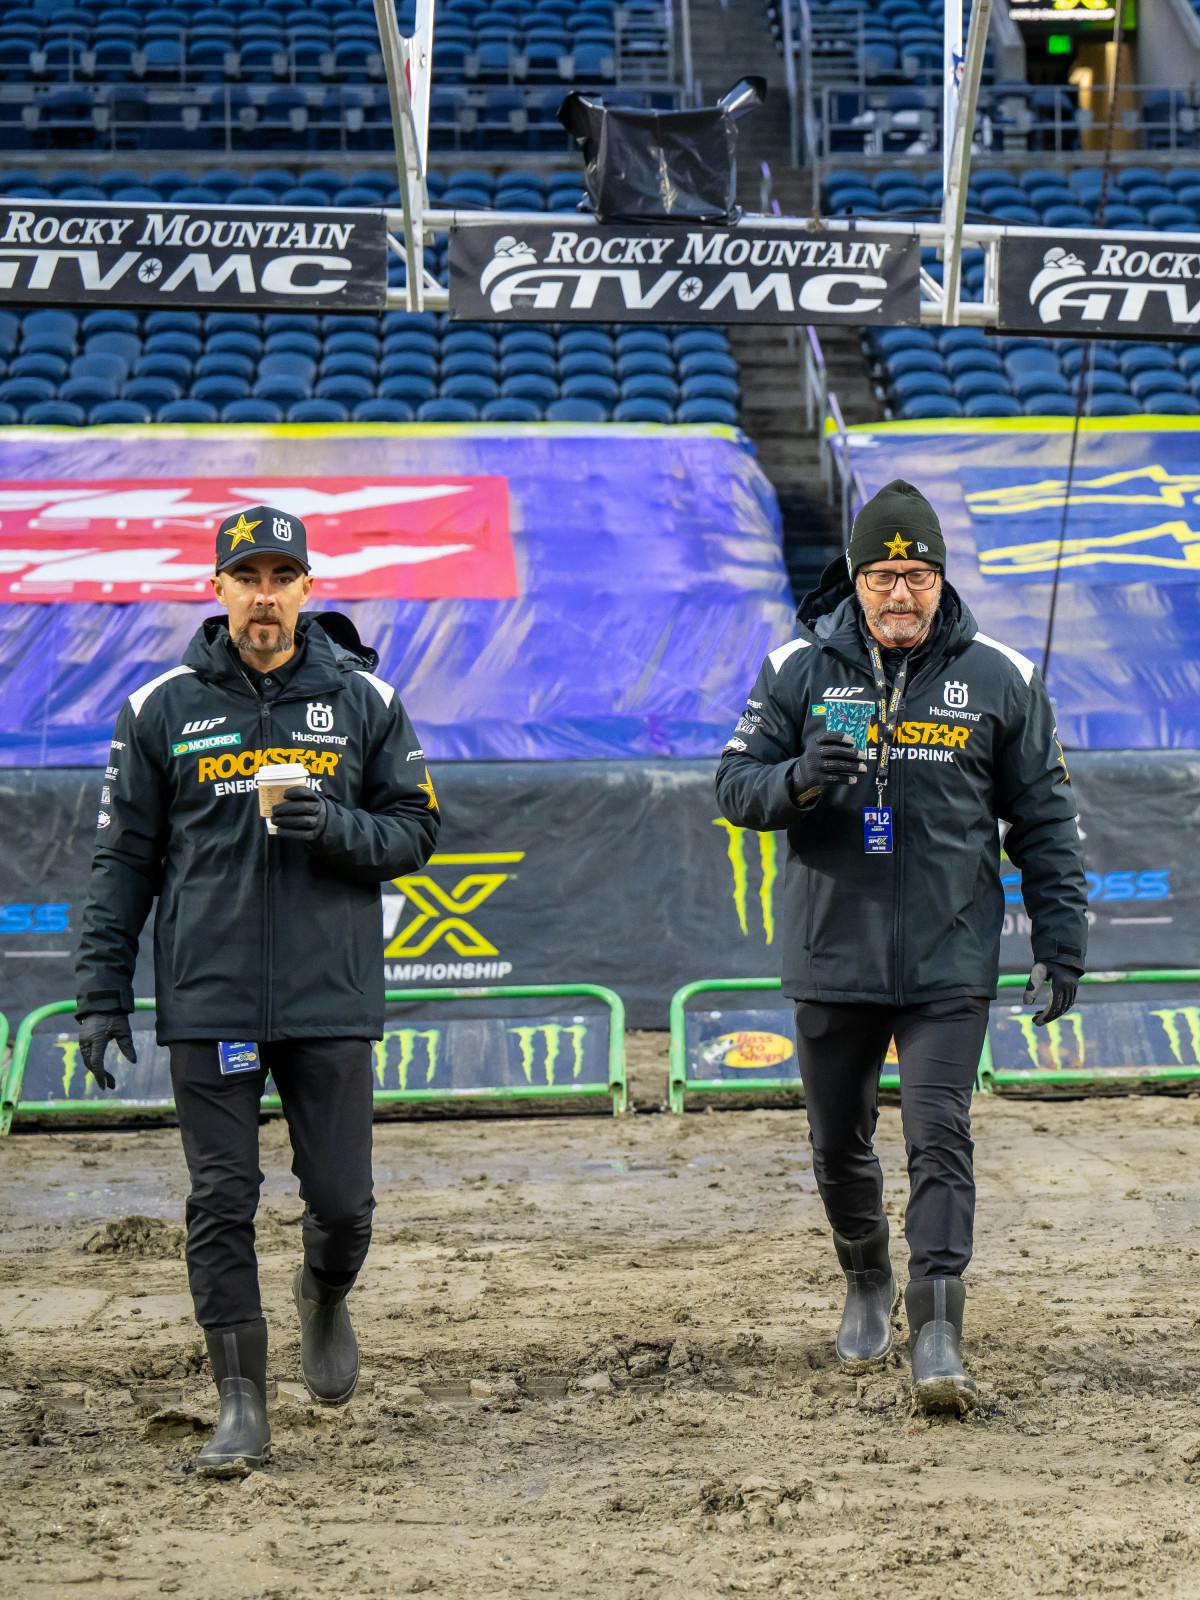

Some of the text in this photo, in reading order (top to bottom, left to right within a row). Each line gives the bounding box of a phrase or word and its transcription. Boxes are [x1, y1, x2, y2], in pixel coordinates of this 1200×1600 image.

[1, 211, 355, 249] ROCKY MOUNTAIN
[543, 232, 889, 269] ROCKY MOUNTAIN
[822, 687, 864, 697] WP
[930, 706, 982, 722] Husqvarna
[182, 717, 227, 734] WP
[188, 733, 239, 751] MOTOREX
[292, 731, 348, 745] Husqvarna
[908, 748, 954, 763] DRINK
